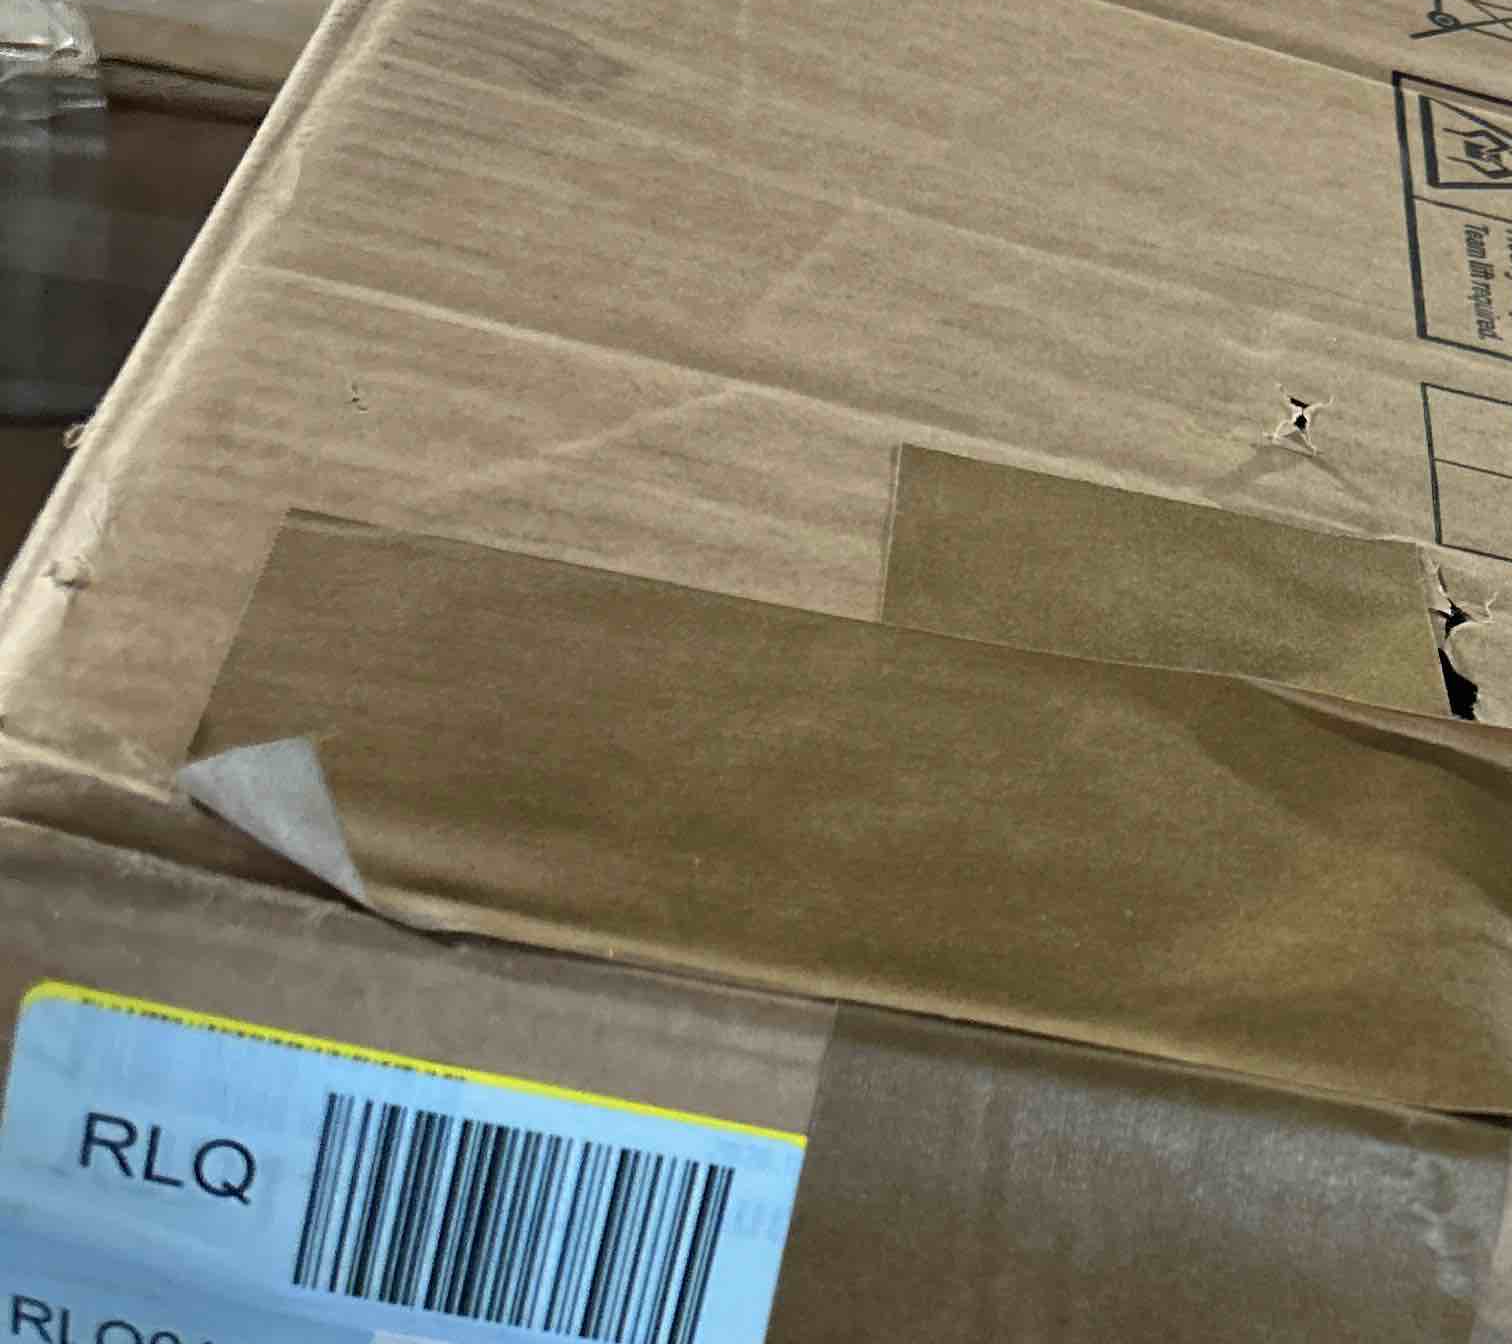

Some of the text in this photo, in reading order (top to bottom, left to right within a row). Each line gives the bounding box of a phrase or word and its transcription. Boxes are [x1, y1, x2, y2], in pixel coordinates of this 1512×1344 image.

[1464, 223, 1490, 260] Team
[1468, 258, 1495, 281] lift
[79, 1110, 257, 1207] RLQ
